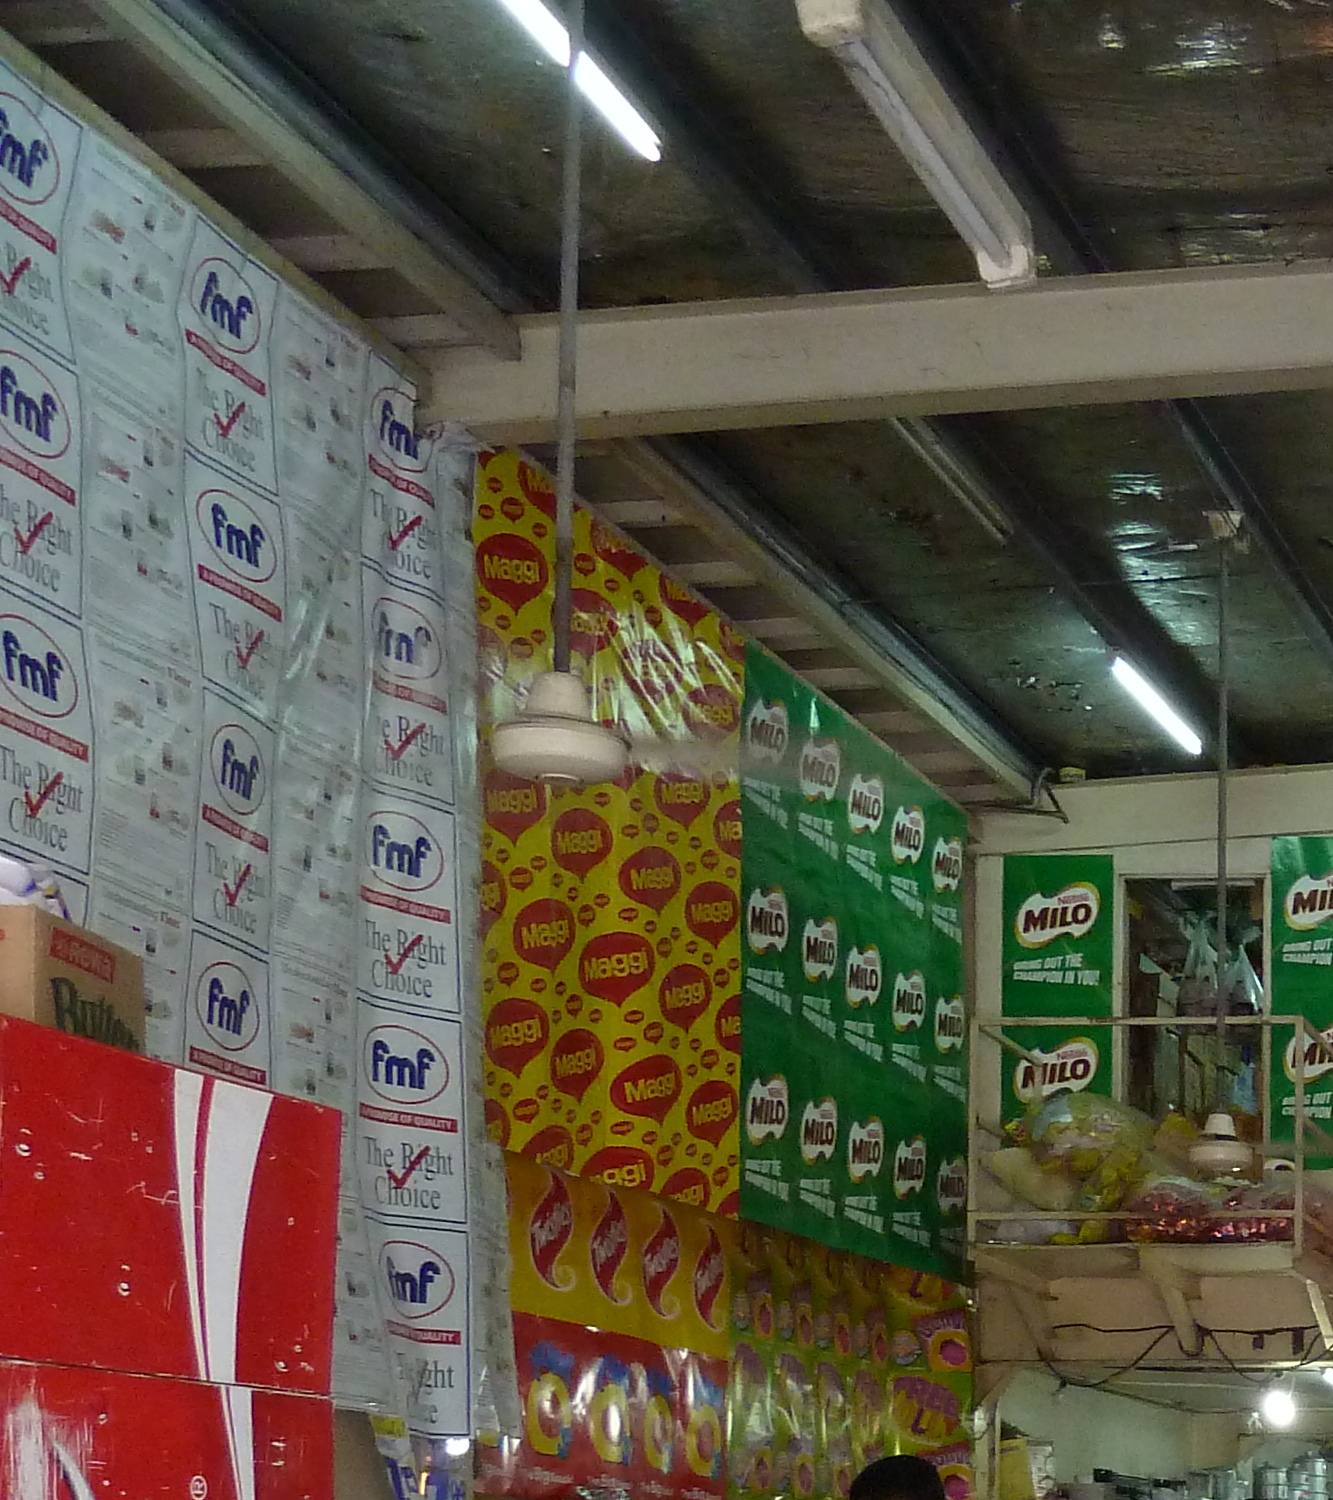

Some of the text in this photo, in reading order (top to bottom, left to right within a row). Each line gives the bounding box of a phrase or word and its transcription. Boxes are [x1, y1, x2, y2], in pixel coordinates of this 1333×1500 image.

[211, 503, 264, 567] fmf
[2, 630, 64, 700] fmf
[220, 739, 257, 800] fmf
[372, 824, 432, 878] fmf
[751, 906, 785, 938] MILO
[1023, 903, 1093, 934] MILO
[365, 920, 391, 952] The
[521, 920, 570, 950] Maggi
[584, 948, 648, 982] Maggi
[849, 963, 878, 992] MILO
[206, 977, 249, 1035] fmf
[372, 1039, 435, 1090] fmf
[624, 1072, 675, 1103] Maggi
[750, 1097, 785, 1126] MILO
[804, 1118, 834, 1146] MILO
[364, 1136, 394, 1168] The
